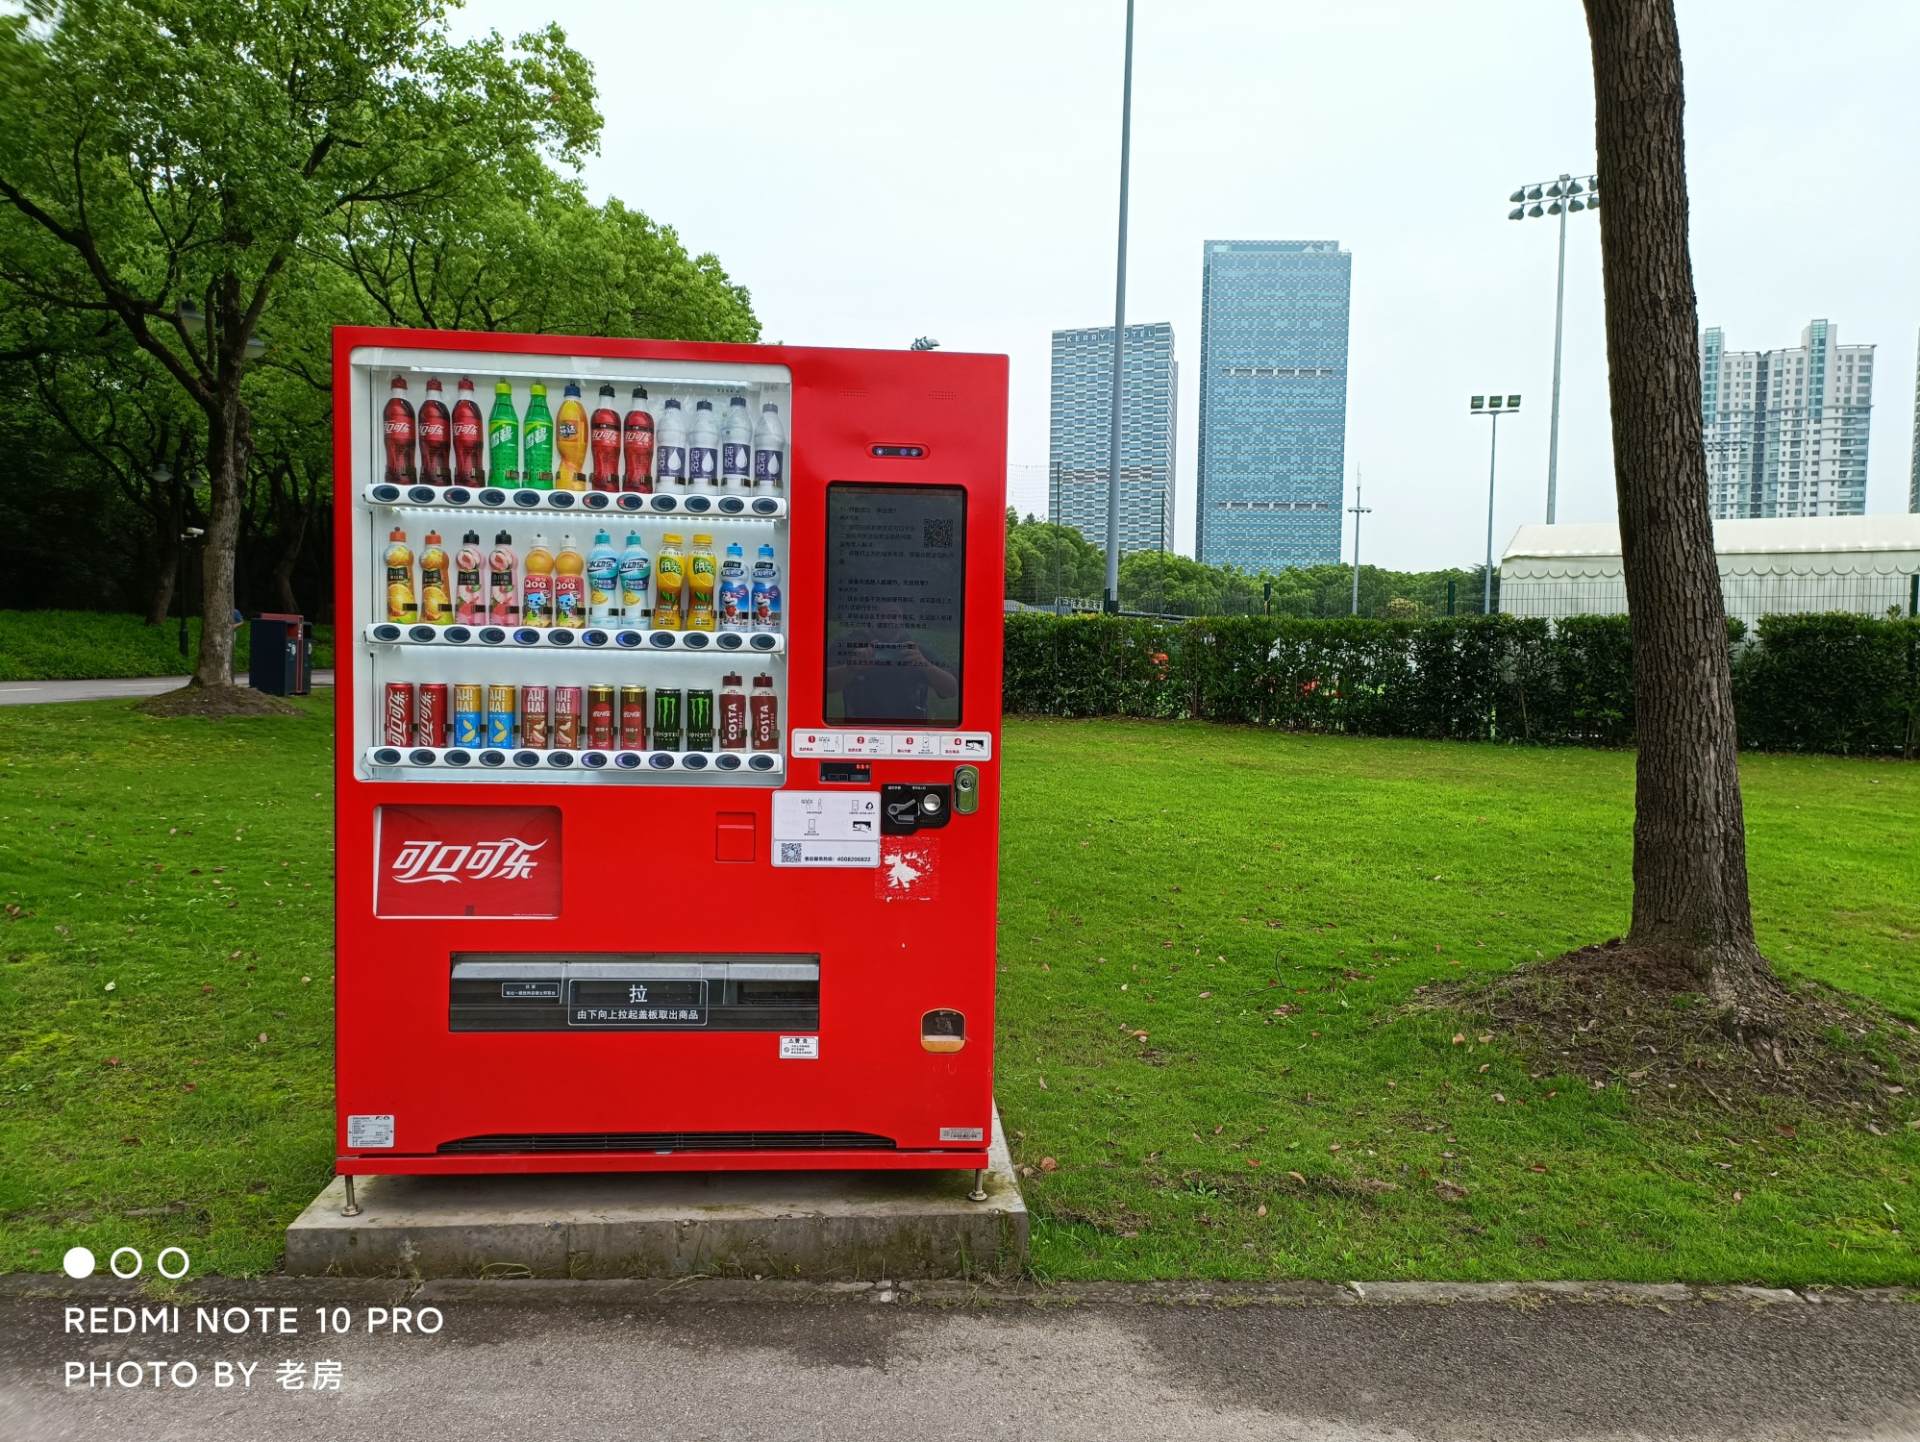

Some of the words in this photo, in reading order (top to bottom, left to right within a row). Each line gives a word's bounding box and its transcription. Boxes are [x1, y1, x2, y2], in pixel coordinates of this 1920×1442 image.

[729, 703, 737, 740] COSTA
[761, 705, 769, 741] COSTA
[392, 838, 548, 883] 可口可乐
[629, 984, 647, 1003] 拉
[577, 1009, 698, 1020] 由下向上拉起盖板取出商品
